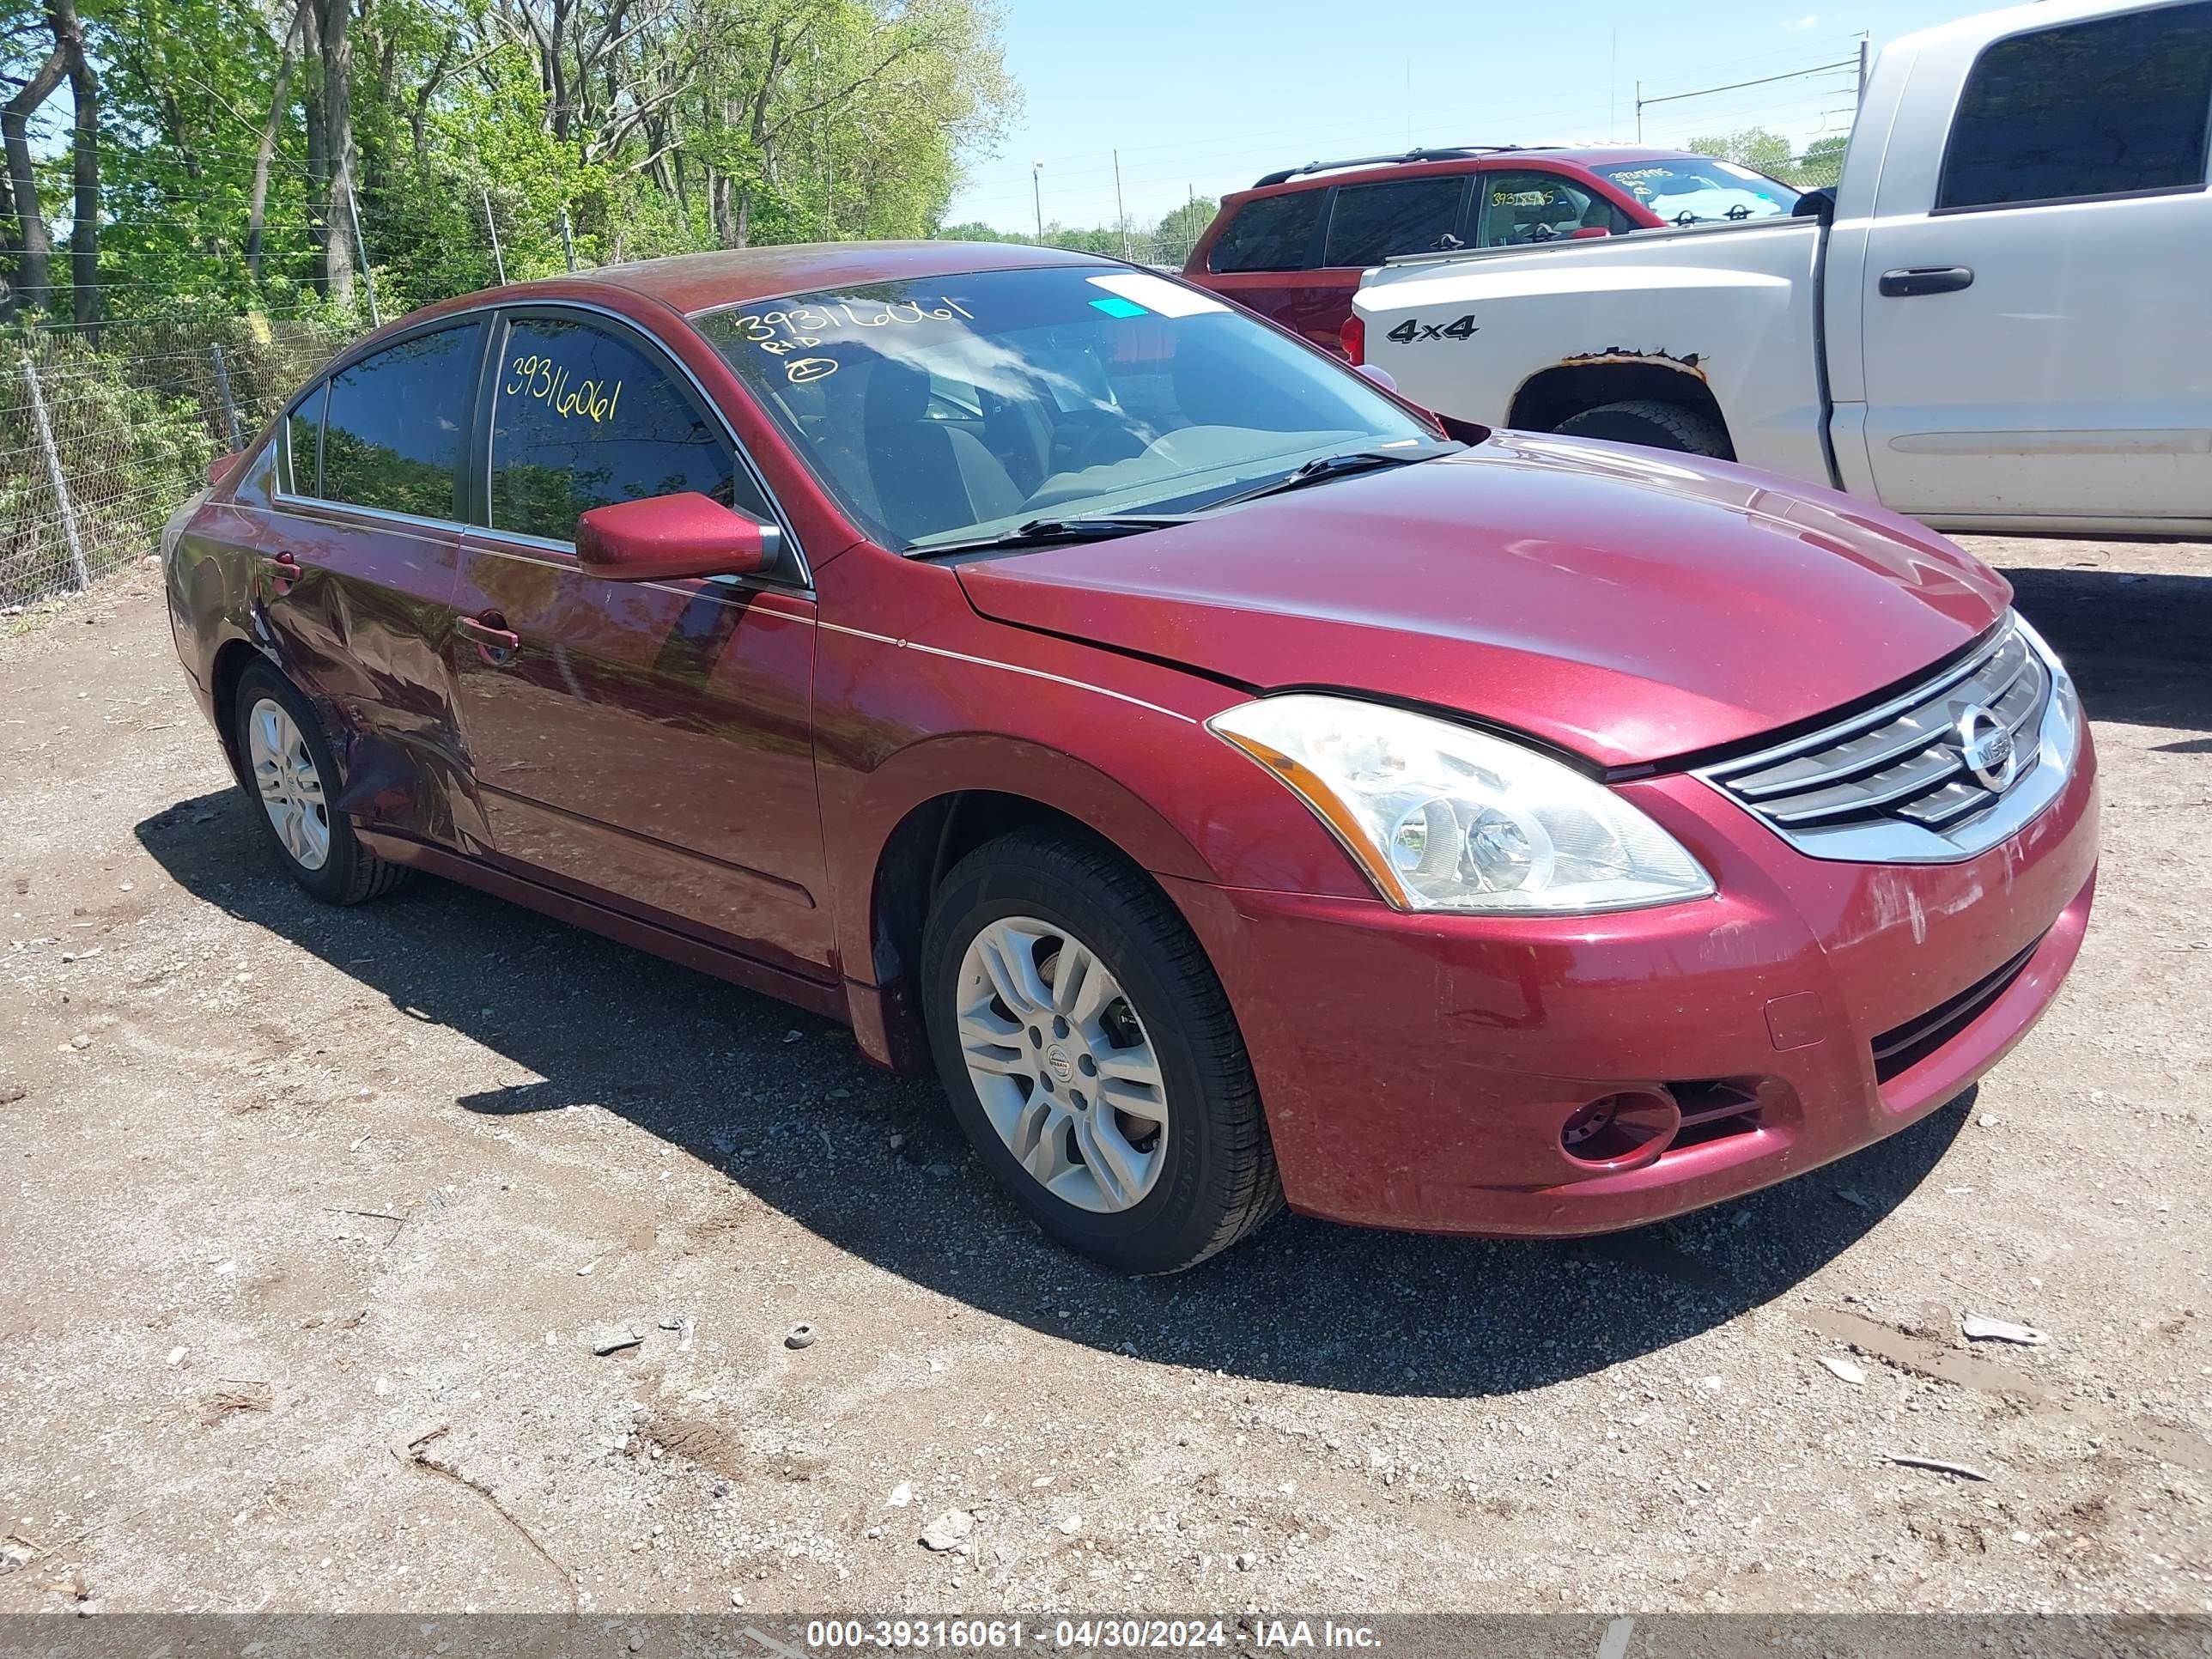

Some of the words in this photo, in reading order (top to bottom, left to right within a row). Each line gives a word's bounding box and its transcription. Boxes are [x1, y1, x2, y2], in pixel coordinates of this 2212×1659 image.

[1492, 191, 1553, 207] 39318485
[736, 296, 975, 341] 39316061
[1386, 315, 1480, 343] 4x4
[507, 356, 622, 422] 39316061
